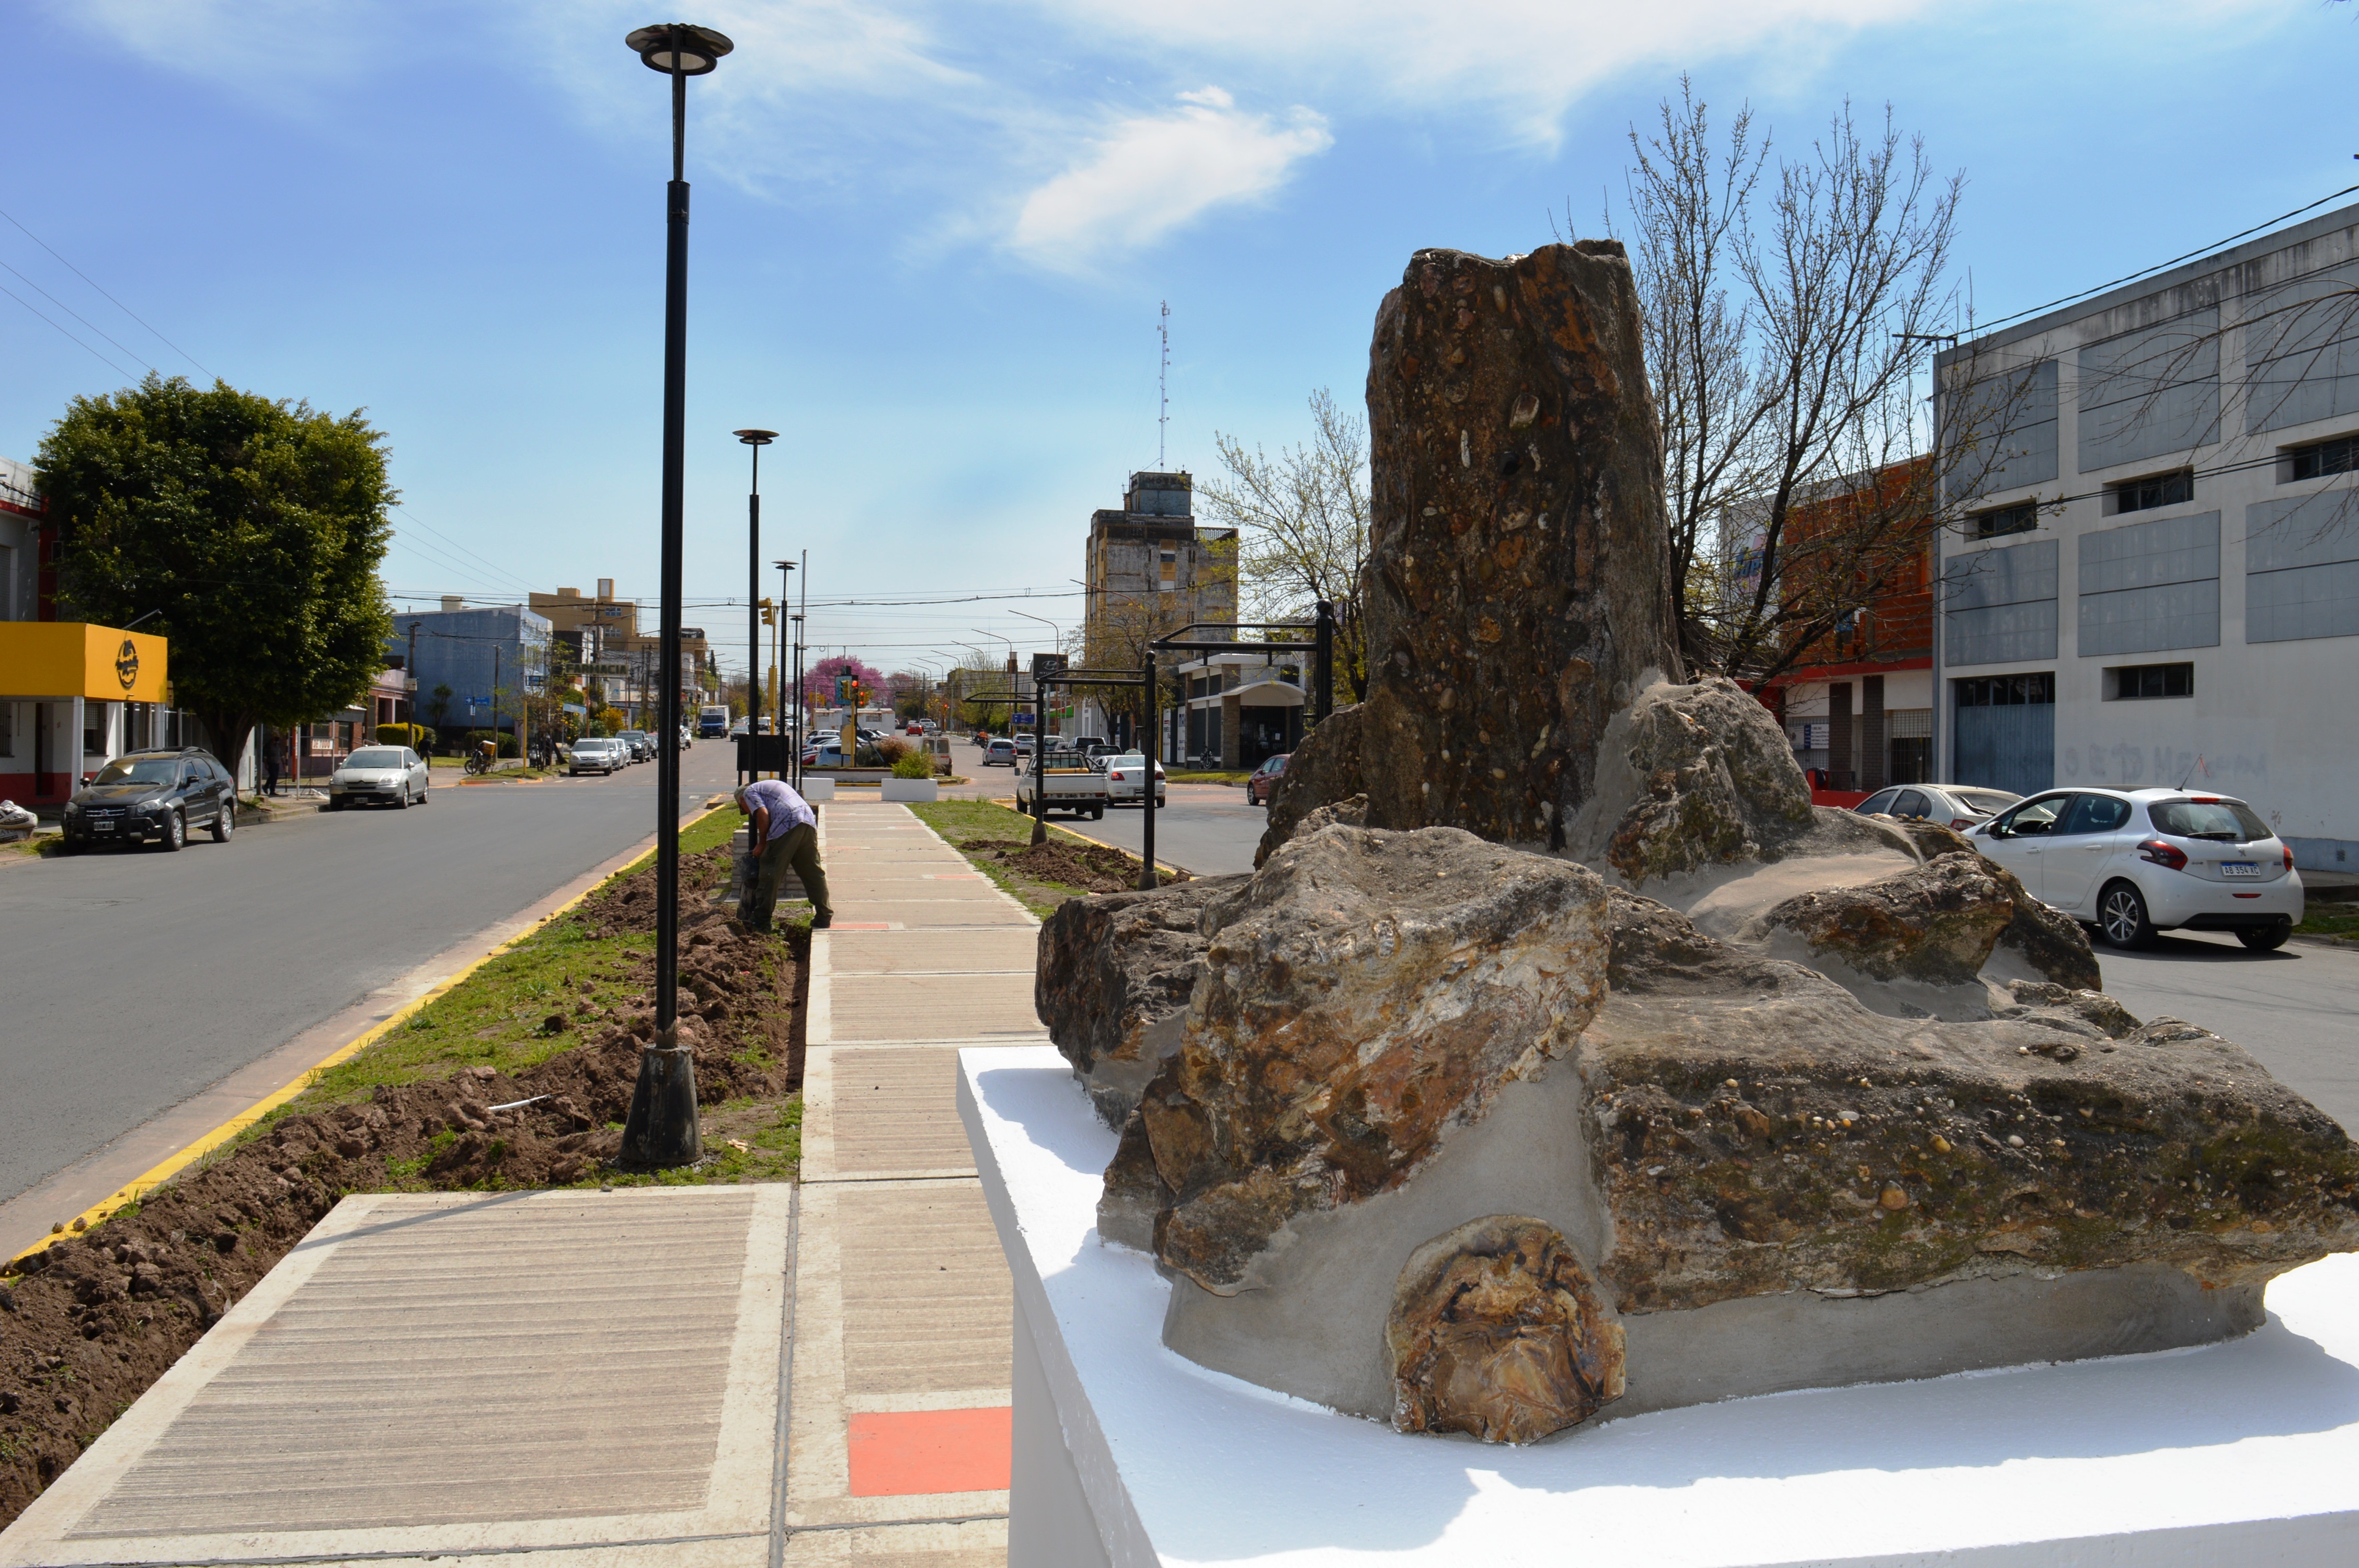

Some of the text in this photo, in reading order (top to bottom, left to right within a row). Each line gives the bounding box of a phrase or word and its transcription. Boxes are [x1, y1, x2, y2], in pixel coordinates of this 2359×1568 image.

[566, 664, 627, 674] FARMACIA
[2225, 866, 2259, 874] AB 354 XC
